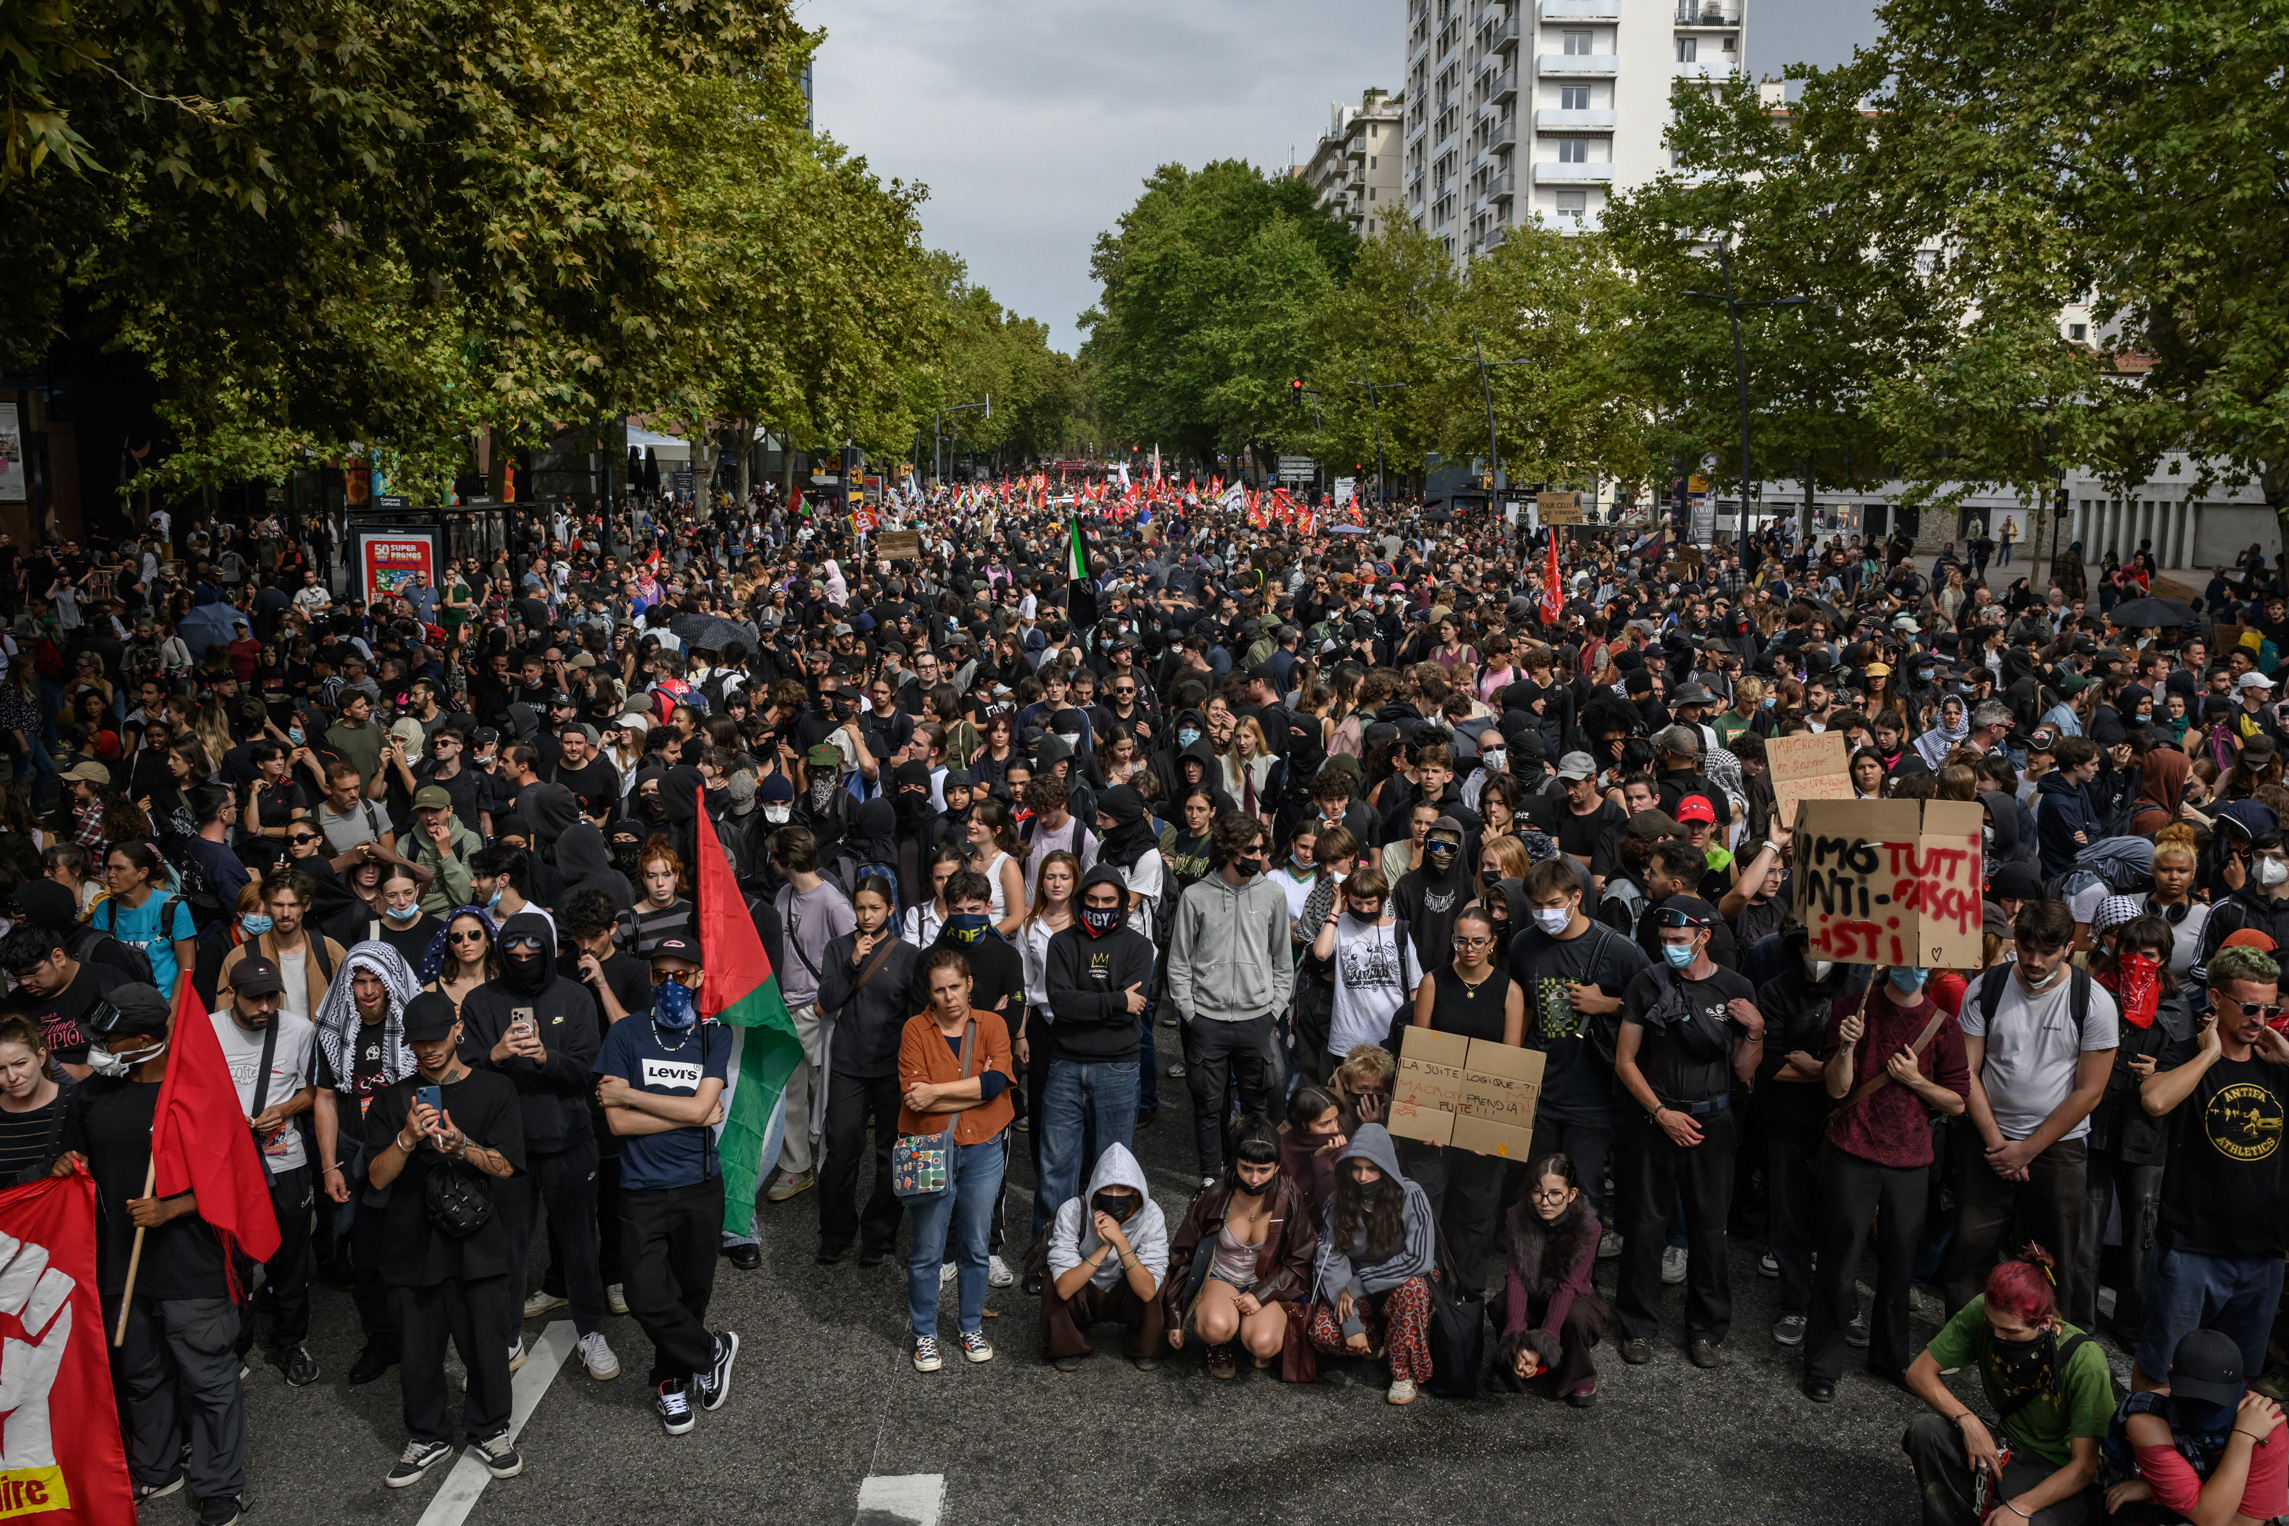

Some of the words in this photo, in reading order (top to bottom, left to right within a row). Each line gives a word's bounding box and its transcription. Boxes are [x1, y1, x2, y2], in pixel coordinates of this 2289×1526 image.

[850, 472, 859, 480] M
[374, 544, 389, 555] 50
[1774, 737, 1824, 761] MACRON
[1402, 1061, 1418, 1071] LA
[1398, 1079, 1462, 1100] MACRON
[1466, 1093, 1505, 1111] PREND
[1507, 1103, 1518, 1116] LA
[2223, 1087, 2266, 1103] ANTIFA
[2215, 1136, 2276, 1157] ATHLETICS
[0, 1475, 49, 1513] ire
